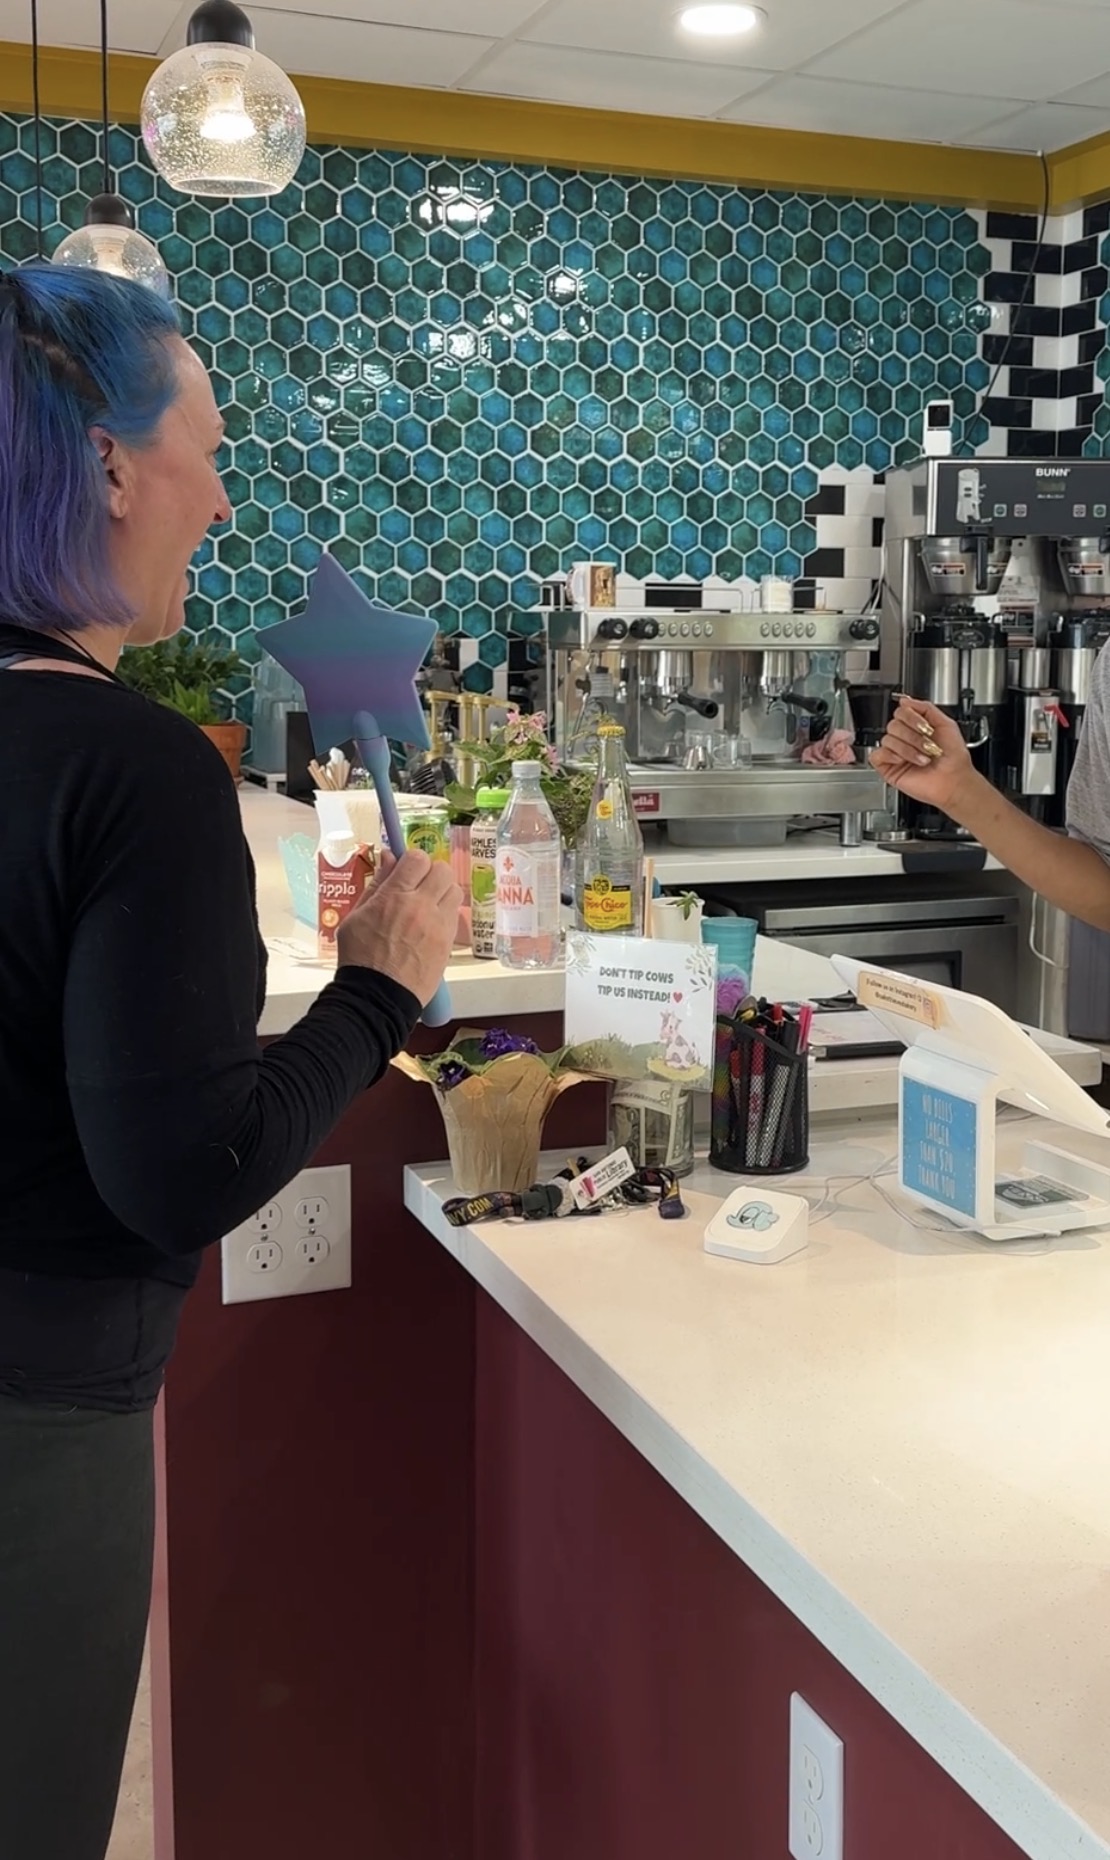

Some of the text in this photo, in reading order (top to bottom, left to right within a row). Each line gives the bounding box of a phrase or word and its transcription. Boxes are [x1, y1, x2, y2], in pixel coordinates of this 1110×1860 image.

[318, 881, 356, 898] ripple
[599, 966, 674, 984] DON'T TIP COWS
[597, 985, 671, 1004] TIP US INSTEAD!
[922, 1094, 953, 1124] NO BILLS
[920, 1140, 936, 1166] THAN
[918, 1164, 941, 1193] THANK
